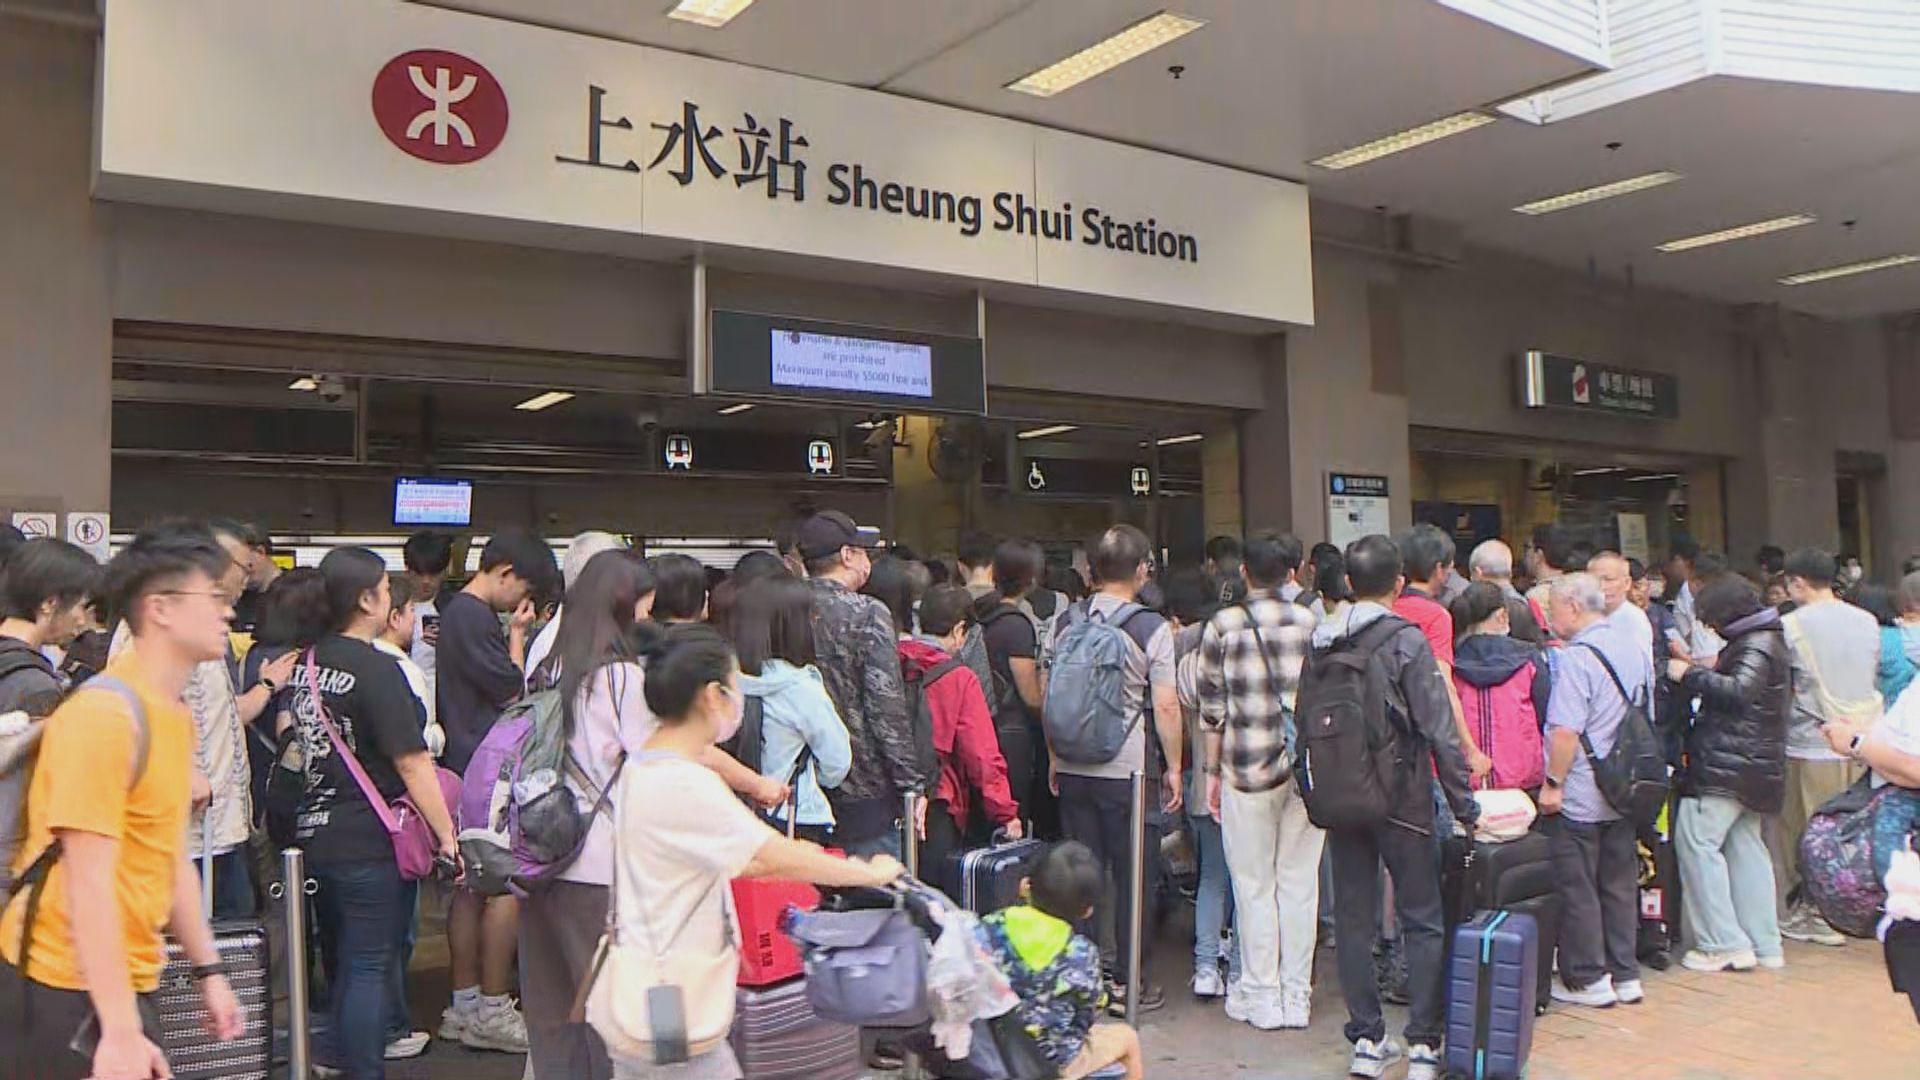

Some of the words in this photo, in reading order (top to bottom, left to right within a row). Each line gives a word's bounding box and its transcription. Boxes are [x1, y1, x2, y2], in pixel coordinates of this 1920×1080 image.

[555, 84, 808, 202] 上水站
[827, 164, 982, 236] Sheung
[993, 192, 1072, 241] Shui
[1082, 208, 1198, 262] Station
[777, 363, 823, 376] Maximum
[825, 367, 859, 380] penalty
[840, 354, 886, 365] prohibited
